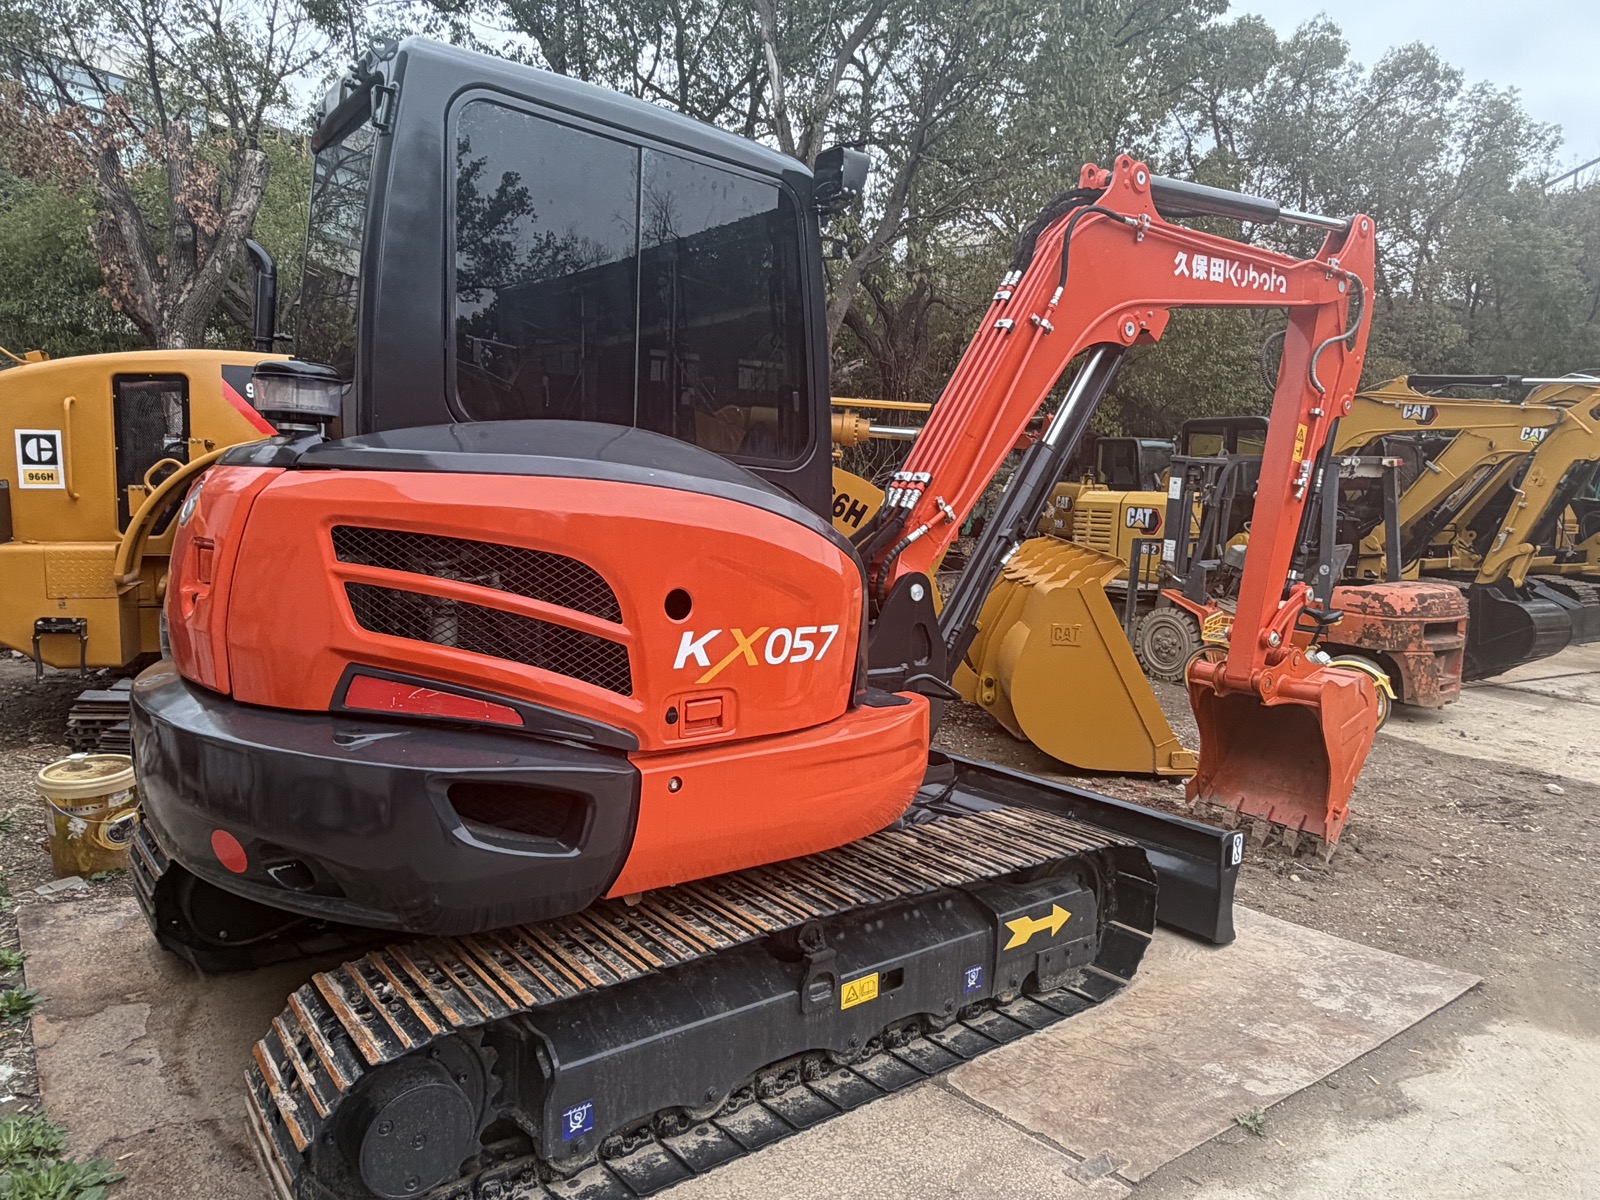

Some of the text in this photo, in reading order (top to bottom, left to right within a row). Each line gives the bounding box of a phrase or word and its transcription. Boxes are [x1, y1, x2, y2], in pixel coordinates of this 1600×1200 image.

[1402, 404, 1431, 420] CAT
[1520, 426, 1549, 443] CAT
[28, 472, 54, 481] 966H
[1056, 496, 1070, 509] CAT
[1126, 507, 1152, 528] CAT
[1054, 627, 1080, 642] CAT
[673, 625, 839, 684] KX057
